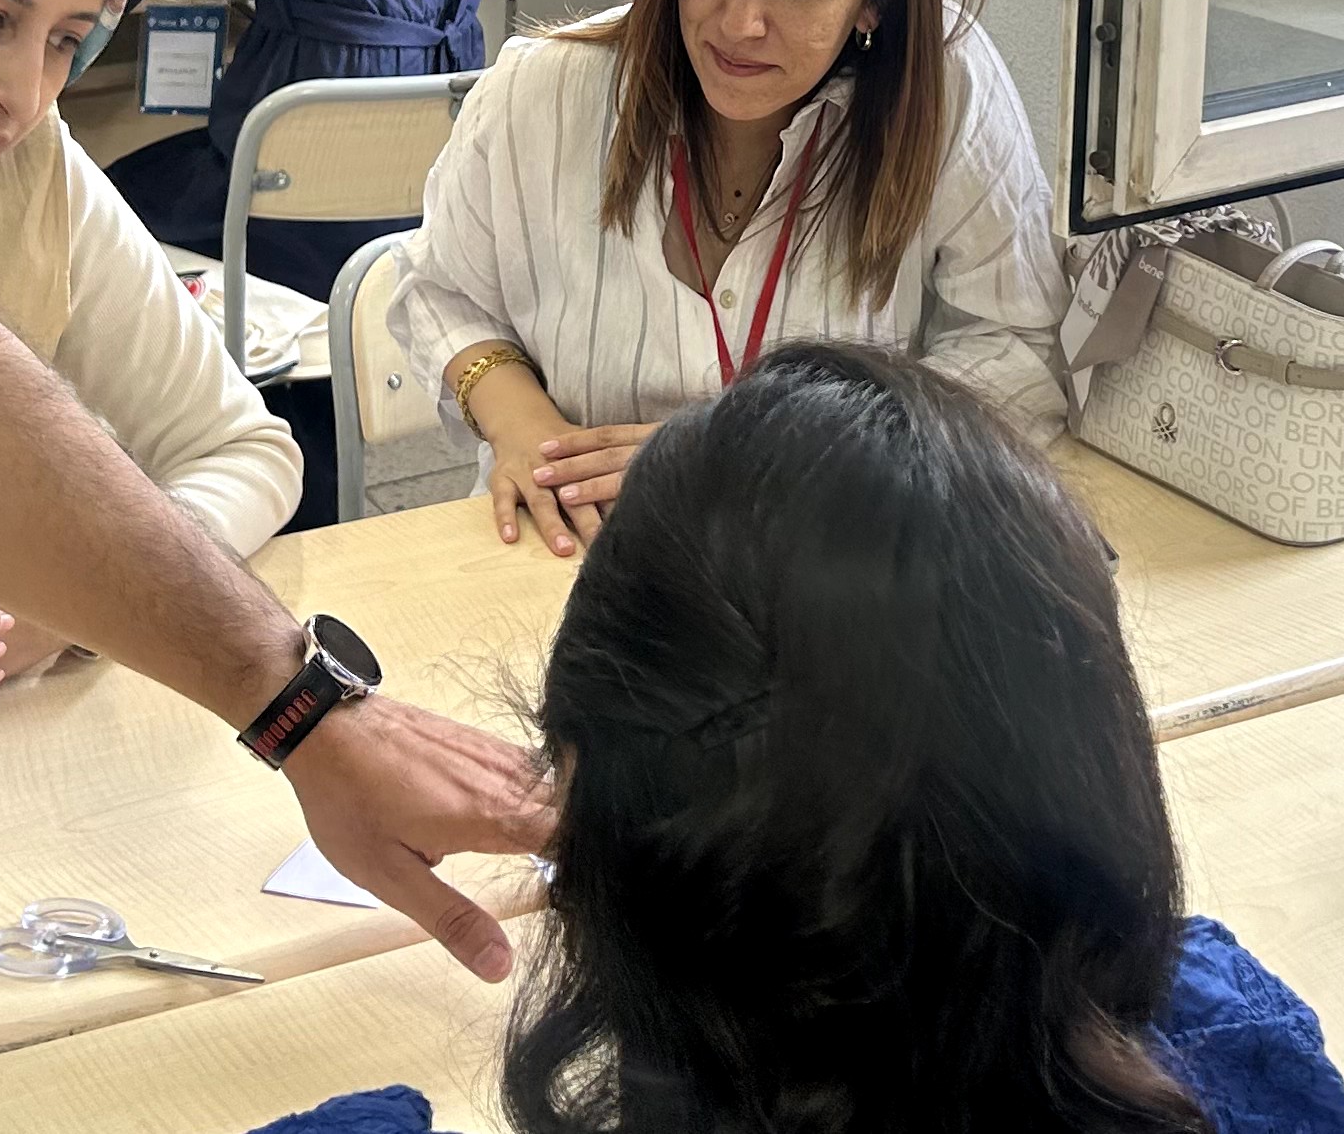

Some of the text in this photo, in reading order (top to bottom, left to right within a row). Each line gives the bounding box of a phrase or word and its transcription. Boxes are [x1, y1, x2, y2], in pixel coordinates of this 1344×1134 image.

[1198, 300, 1271, 352] COLORS
[1167, 366, 1242, 419] COLORS
[1245, 405, 1277, 433] OF
[1178, 450, 1259, 507] COLORS
[1265, 491, 1307, 516] OF
